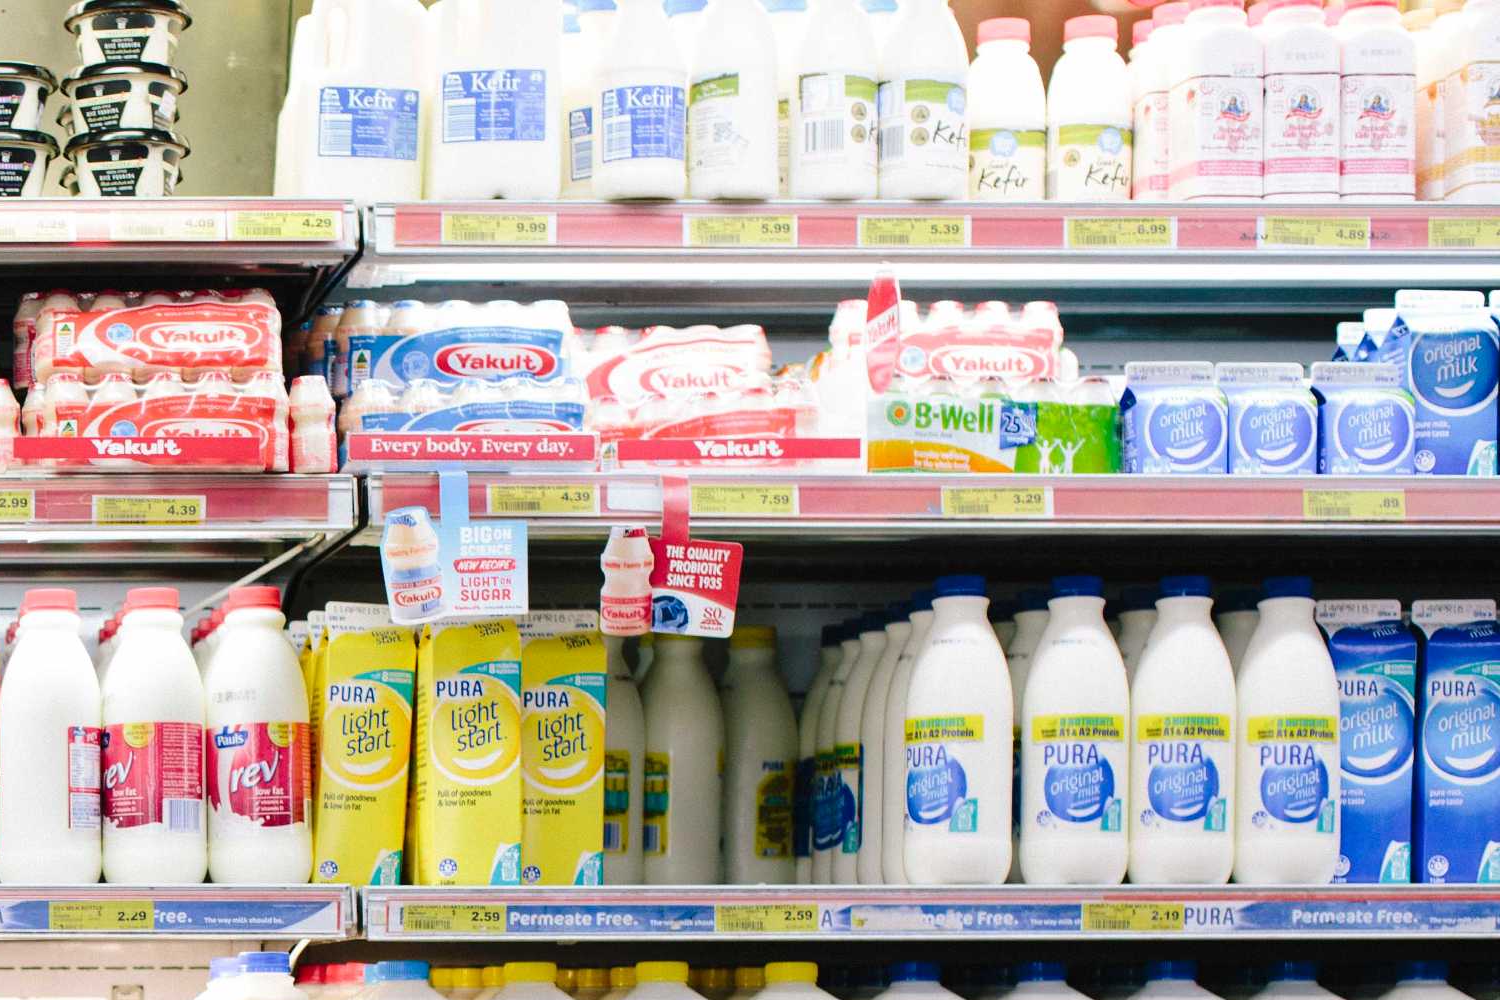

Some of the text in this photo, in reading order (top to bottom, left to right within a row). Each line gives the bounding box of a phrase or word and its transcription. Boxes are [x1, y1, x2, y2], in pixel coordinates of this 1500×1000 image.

[472, 72, 521, 93] Kefir
[626, 87, 672, 108] Kefir
[302, 217, 332, 229] 4.29
[516, 222, 546, 233] 9.99
[761, 223, 790, 234] 5.99
[930, 223, 960, 235] 5.39
[1335, 230, 1365, 241] 4.89
[158, 328, 240, 346] Yakult
[456, 352, 538, 373] Yakult
[914, 404, 994, 433] B-Well
[1160, 404, 1207, 427] original
[93, 439, 181, 456] Yakult
[371, 436, 574, 456] Every body. Every day.
[0, 498, 28, 509] 2.99
[760, 494, 789, 505] 7.59
[1013, 493, 1041, 505] 3.29
[167, 504, 196, 516] 4.39
[460, 544, 512, 555] SCIENCE
[666, 546, 730, 562] THE QUALITY
[457, 560, 510, 570] NEW RECIPE
[669, 560, 723, 574] PROBIOTIC
[667, 574, 722, 589] SINCE 1935
[460, 589, 512, 600] SUGAR
[437, 681, 483, 697] PURA
[341, 709, 390, 736] light
[537, 712, 584, 740] light
[347, 730, 391, 757] start
[1450, 724, 1492, 750] milk
[543, 734, 586, 761] start
[1044, 746, 1099, 766] PURA
[230, 751, 279, 789] rev
[117, 911, 147, 921] 2.29
[471, 911, 500, 922] 2.59
[509, 911, 639, 931] Permeate Free.
[784, 911, 813, 922] 2.59
[1151, 911, 1179, 922] 2.19
[1292, 909, 1418, 929] Permeate Free.
